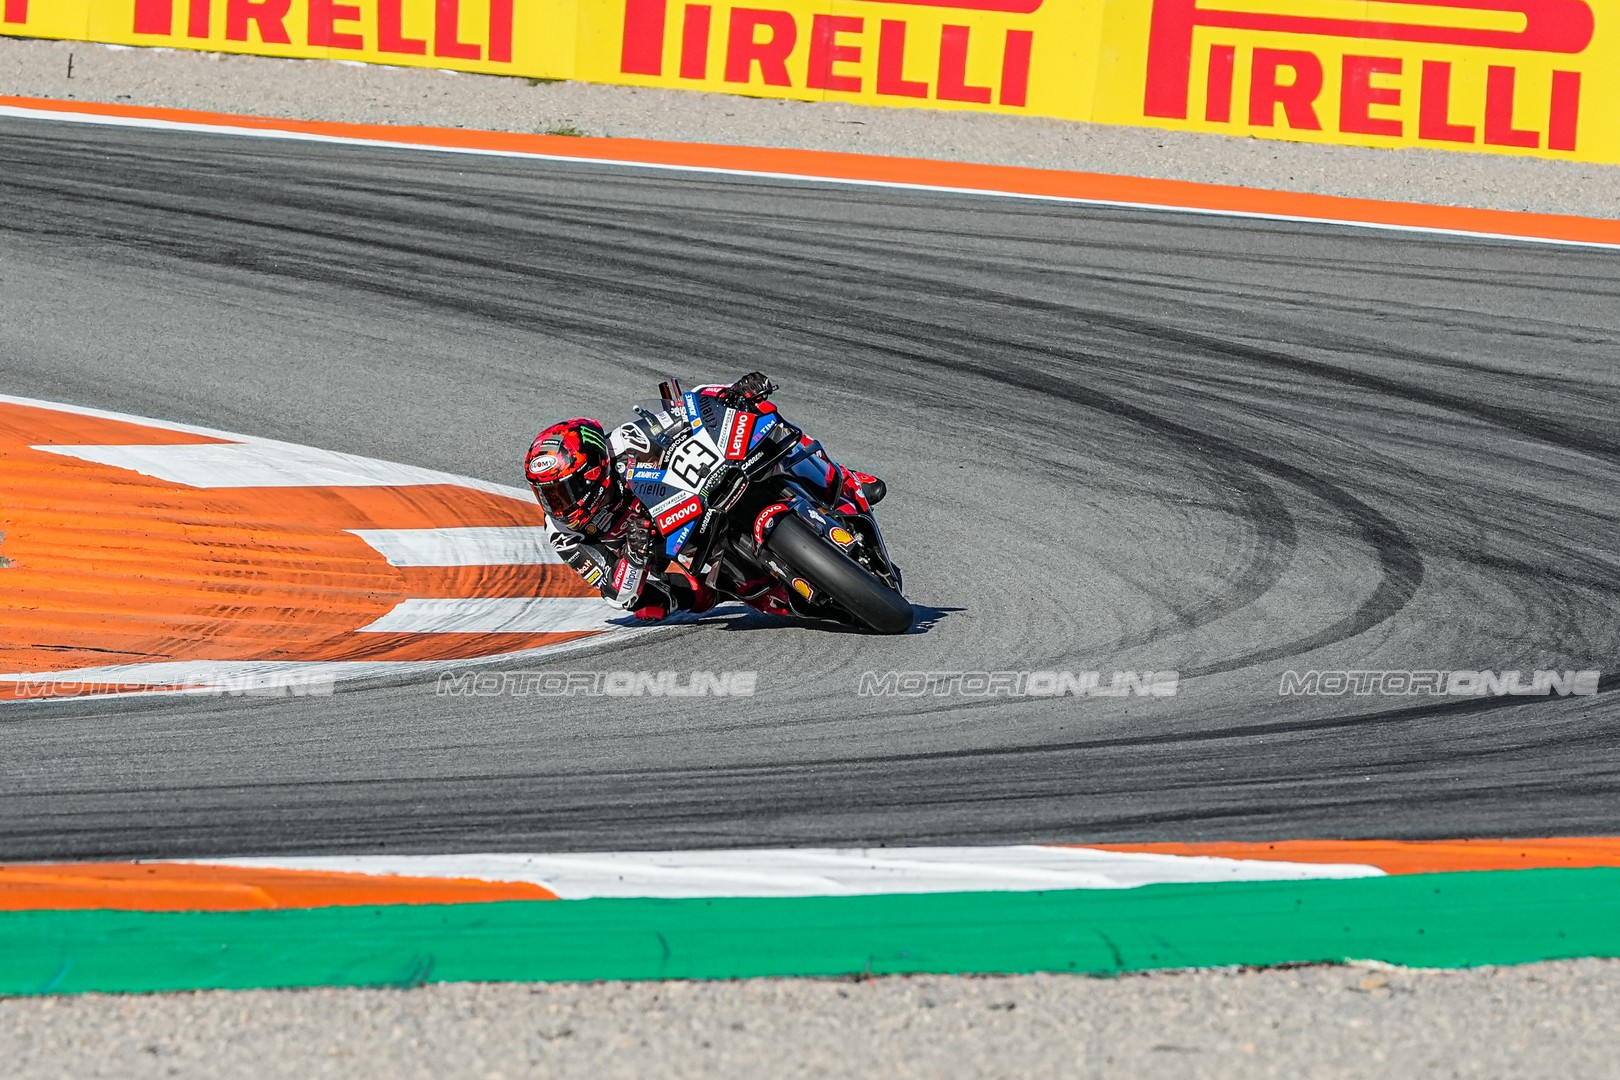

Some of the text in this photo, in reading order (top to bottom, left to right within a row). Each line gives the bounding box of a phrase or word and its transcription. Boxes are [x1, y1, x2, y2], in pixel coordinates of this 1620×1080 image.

[133, 0, 514, 64] IRELLI
[1143, 0, 1596, 152] PIRELLI
[729, 414, 748, 456] Lenovo
[760, 419, 776, 434] TIM
[672, 440, 719, 489] 63
[659, 502, 698, 530] Lenovo
[676, 526, 690, 544] TIM
[755, 504, 782, 541] Lenovo
